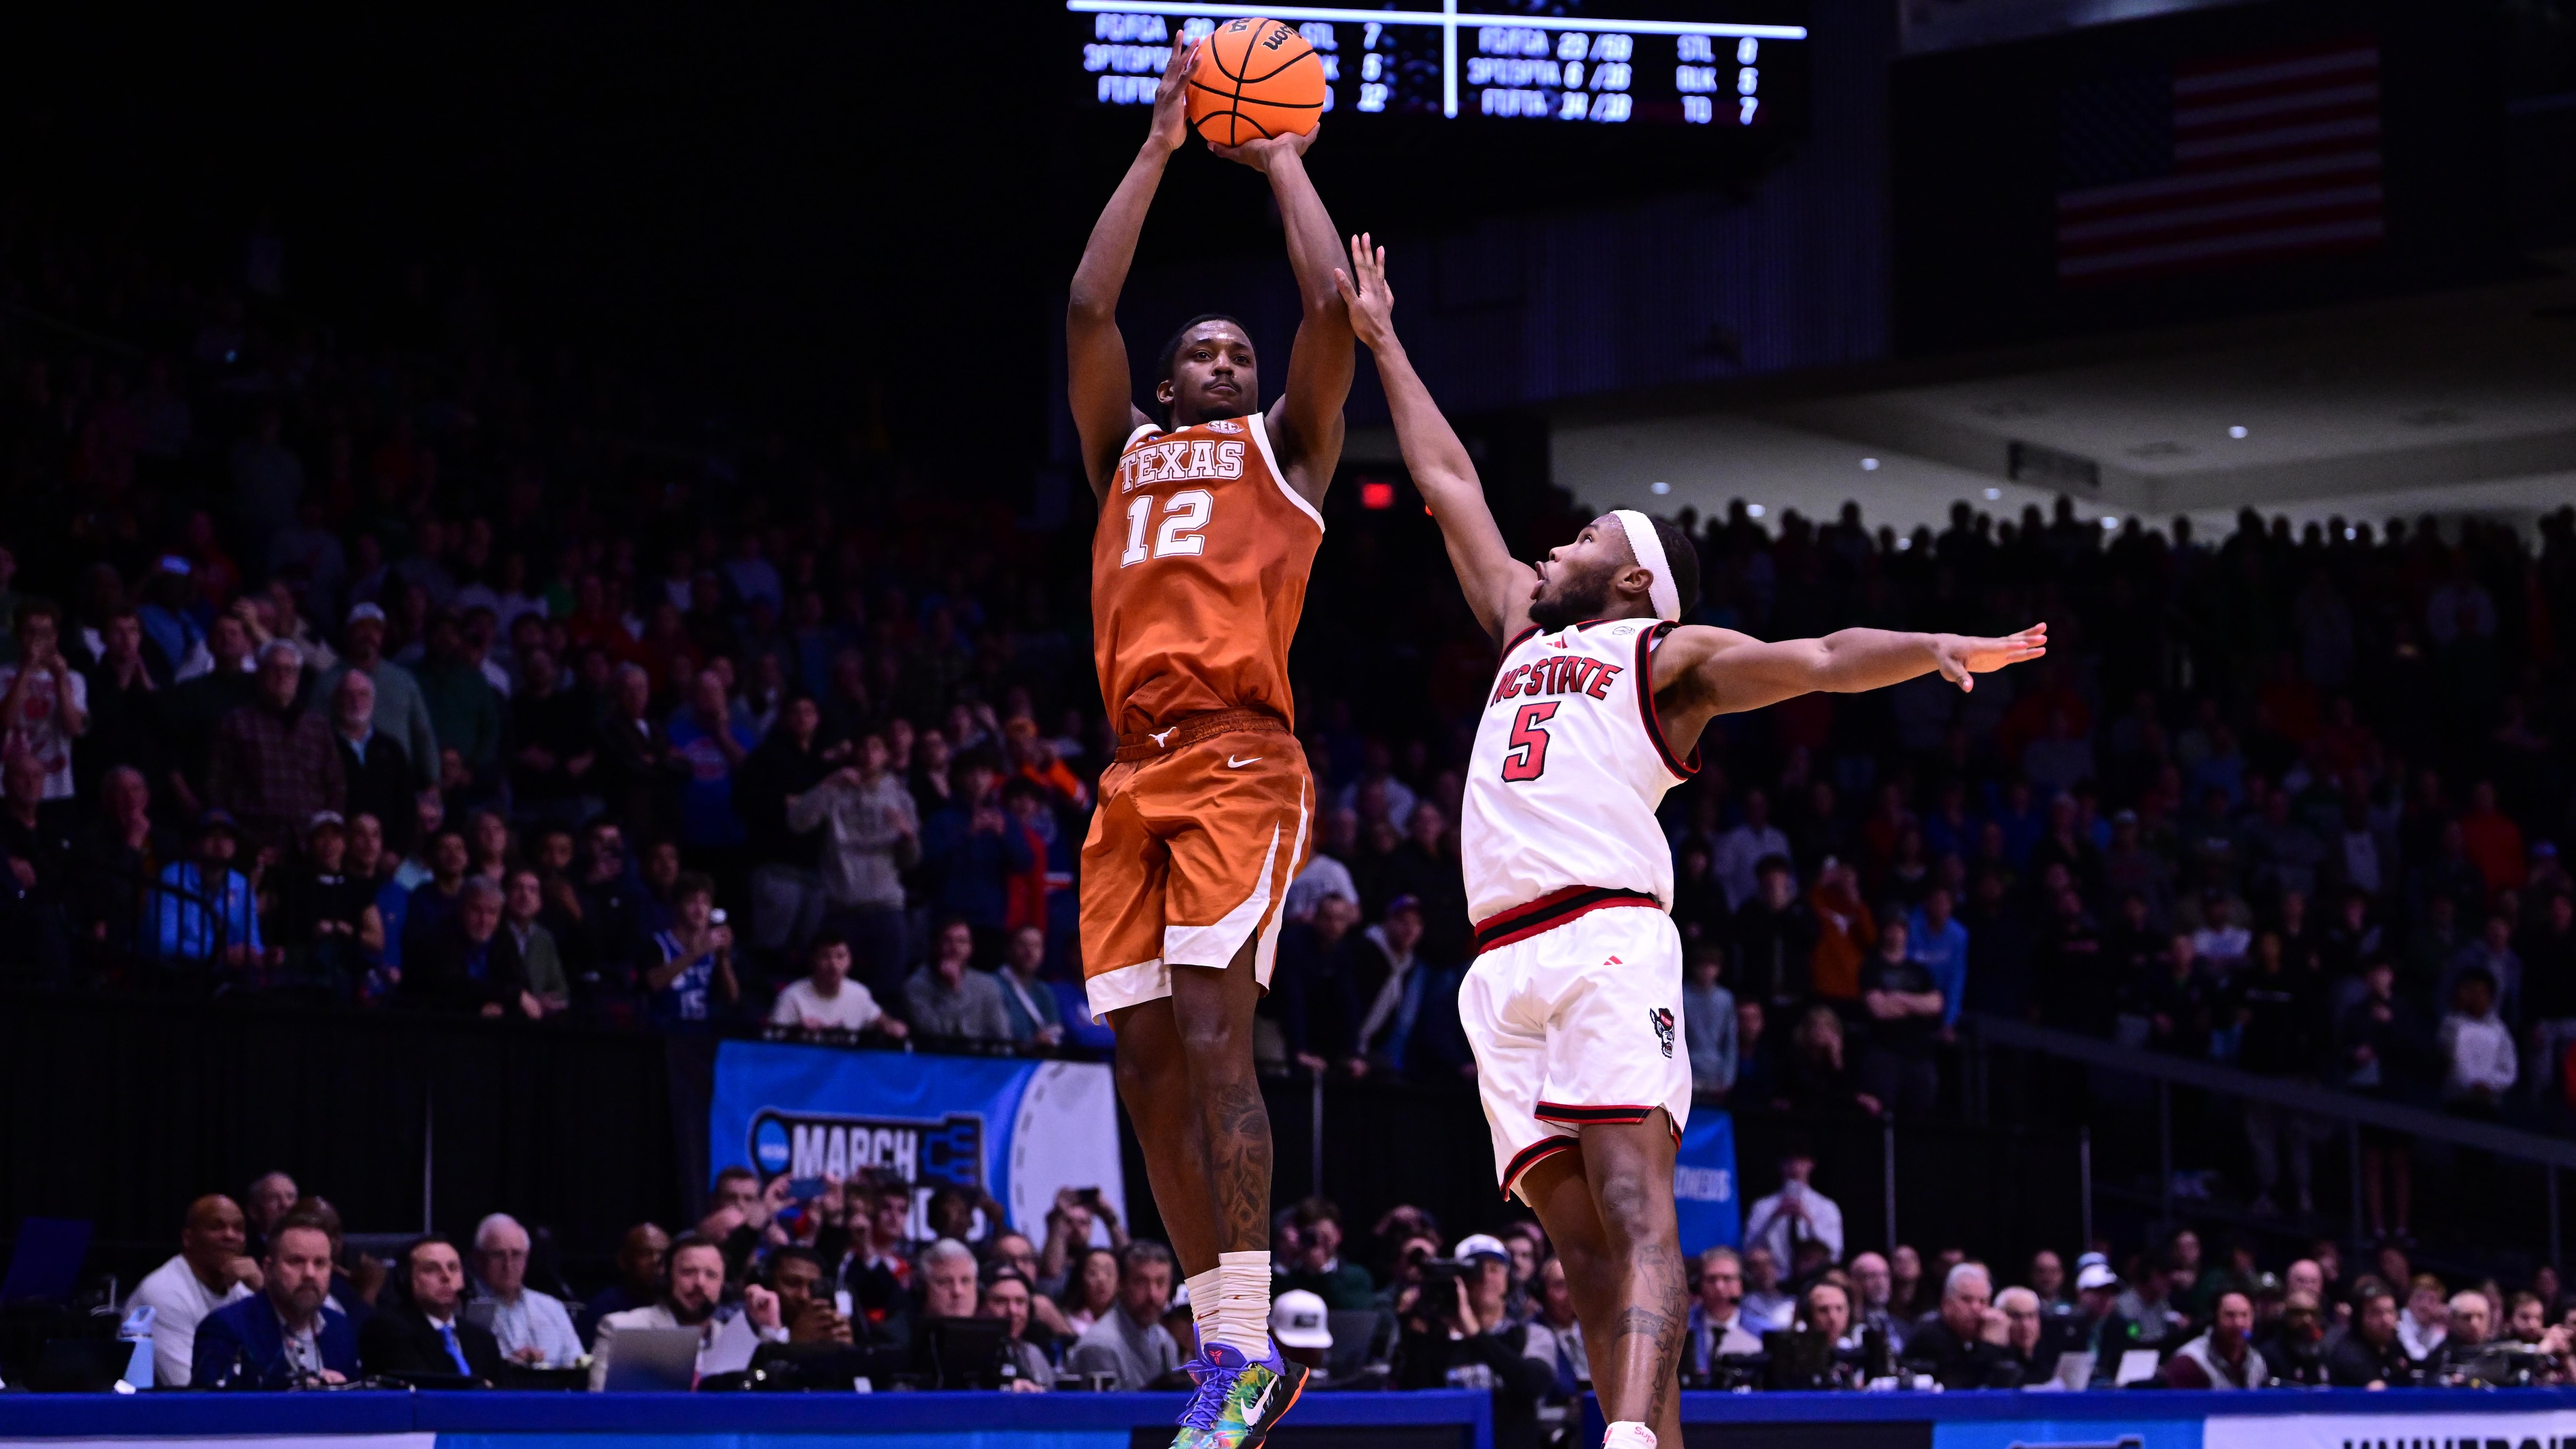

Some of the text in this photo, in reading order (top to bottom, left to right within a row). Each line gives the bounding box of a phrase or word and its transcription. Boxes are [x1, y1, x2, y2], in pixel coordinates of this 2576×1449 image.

[1740, 97, 1758, 124] 7
[1210, 421, 1237, 430] SEC
[1119, 440, 1245, 494] TEXAS
[1120, 489, 1213, 568] 12
[1490, 656, 1624, 708] NC STATE
[1501, 701, 1562, 783] 5
[792, 1123, 919, 1184] MARCH
